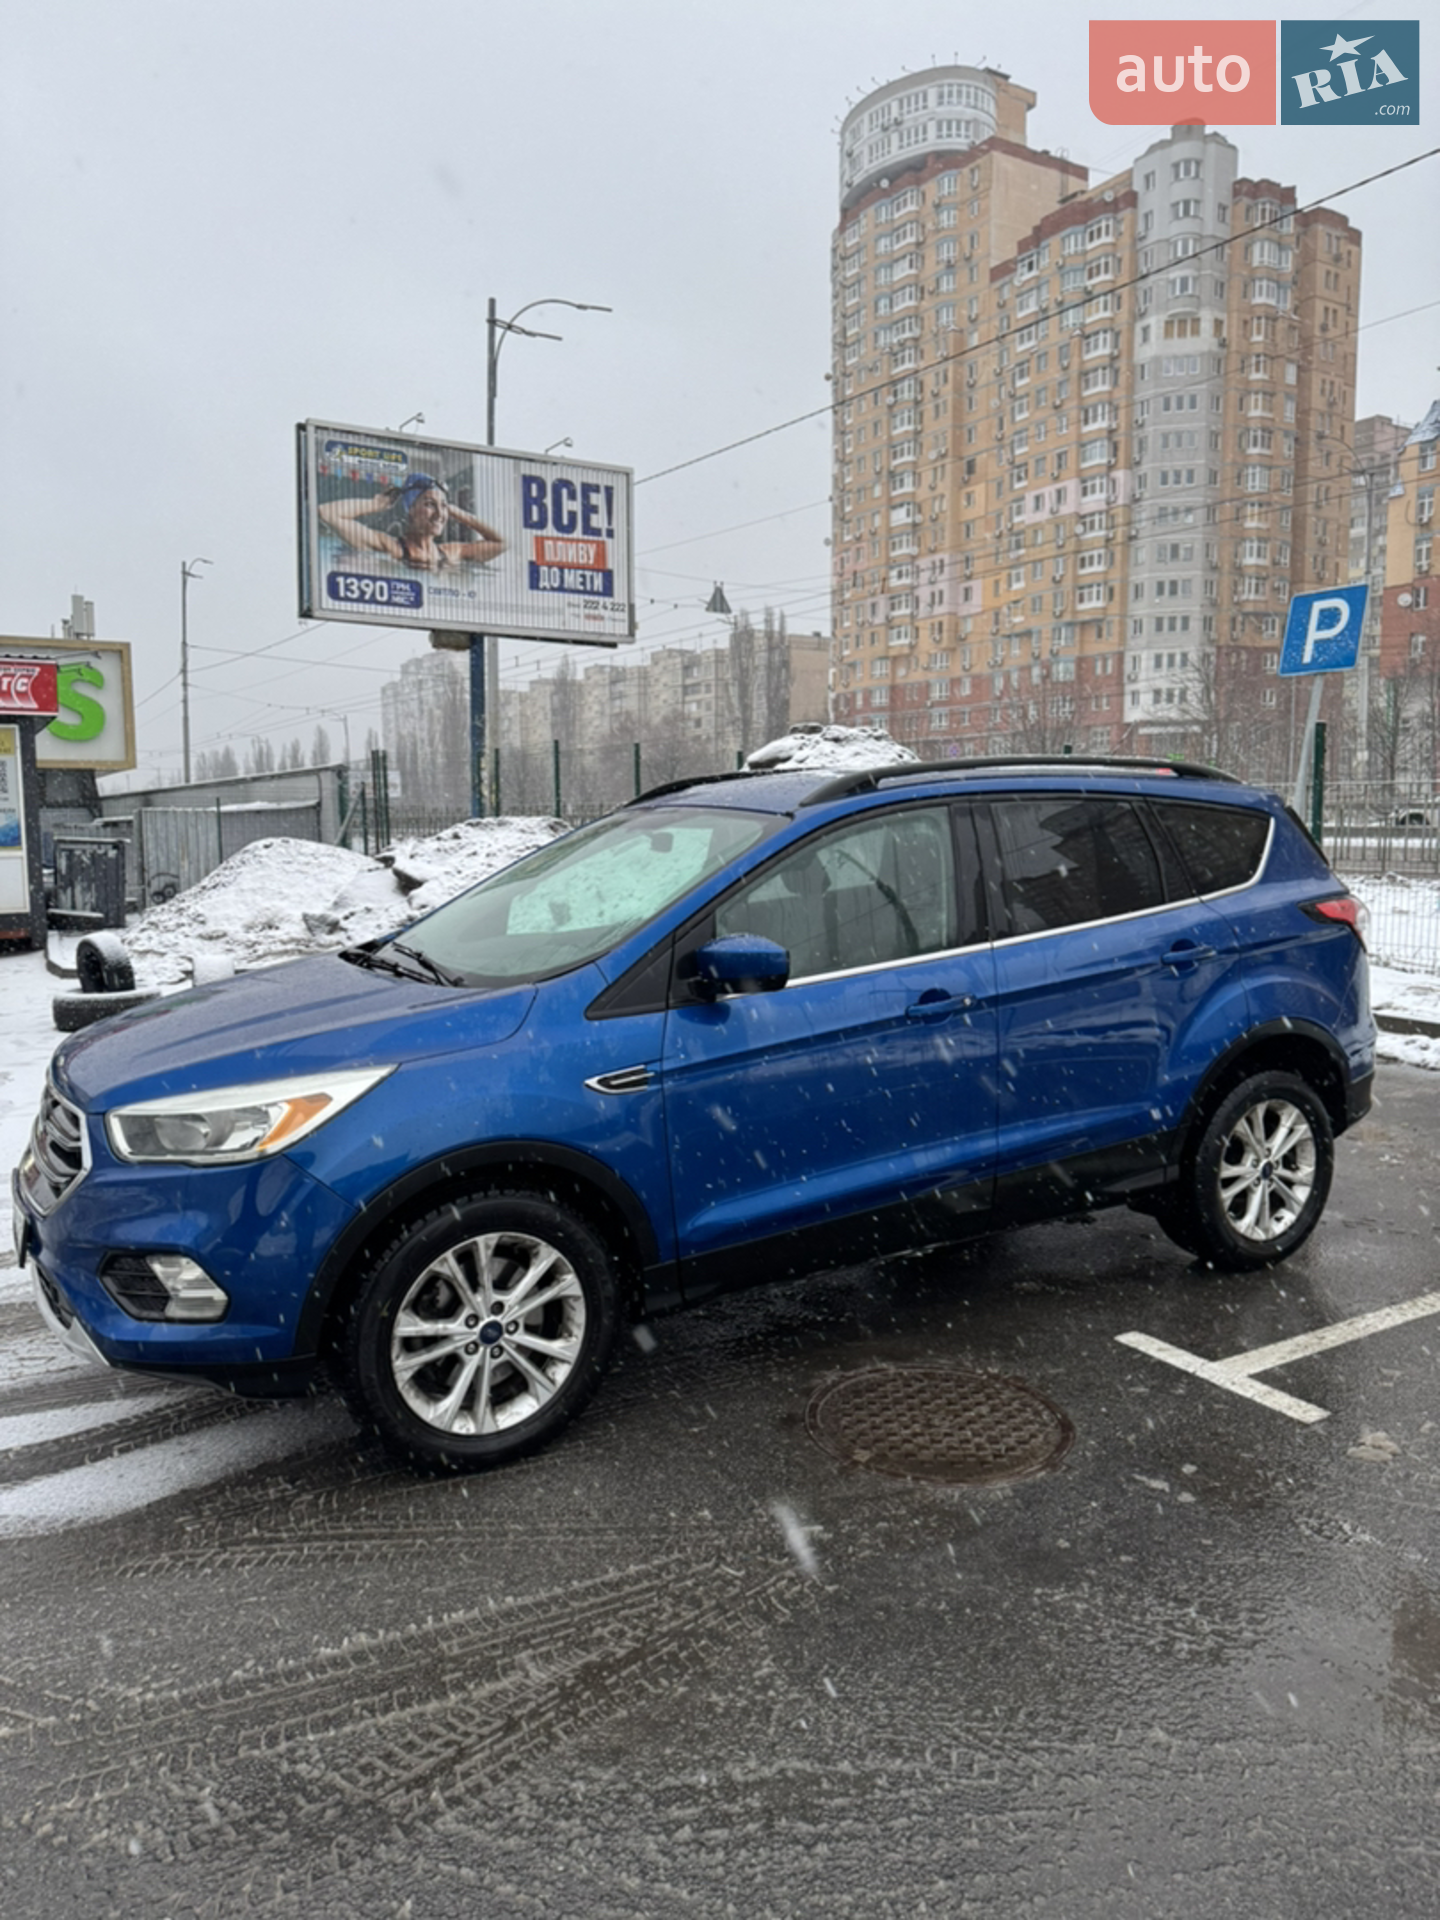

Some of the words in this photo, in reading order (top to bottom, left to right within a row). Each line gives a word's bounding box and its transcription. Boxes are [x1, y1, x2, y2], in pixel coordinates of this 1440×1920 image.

[521, 474, 614, 539] ВСЕ!
[543, 539, 598, 566] ПЛИВУ
[335, 576, 389, 602] 1390
[538, 566, 560, 590] ДО
[563, 567, 604, 593] МЕТИ
[1302, 597, 1350, 664] P
[46, 663, 106, 741] S
